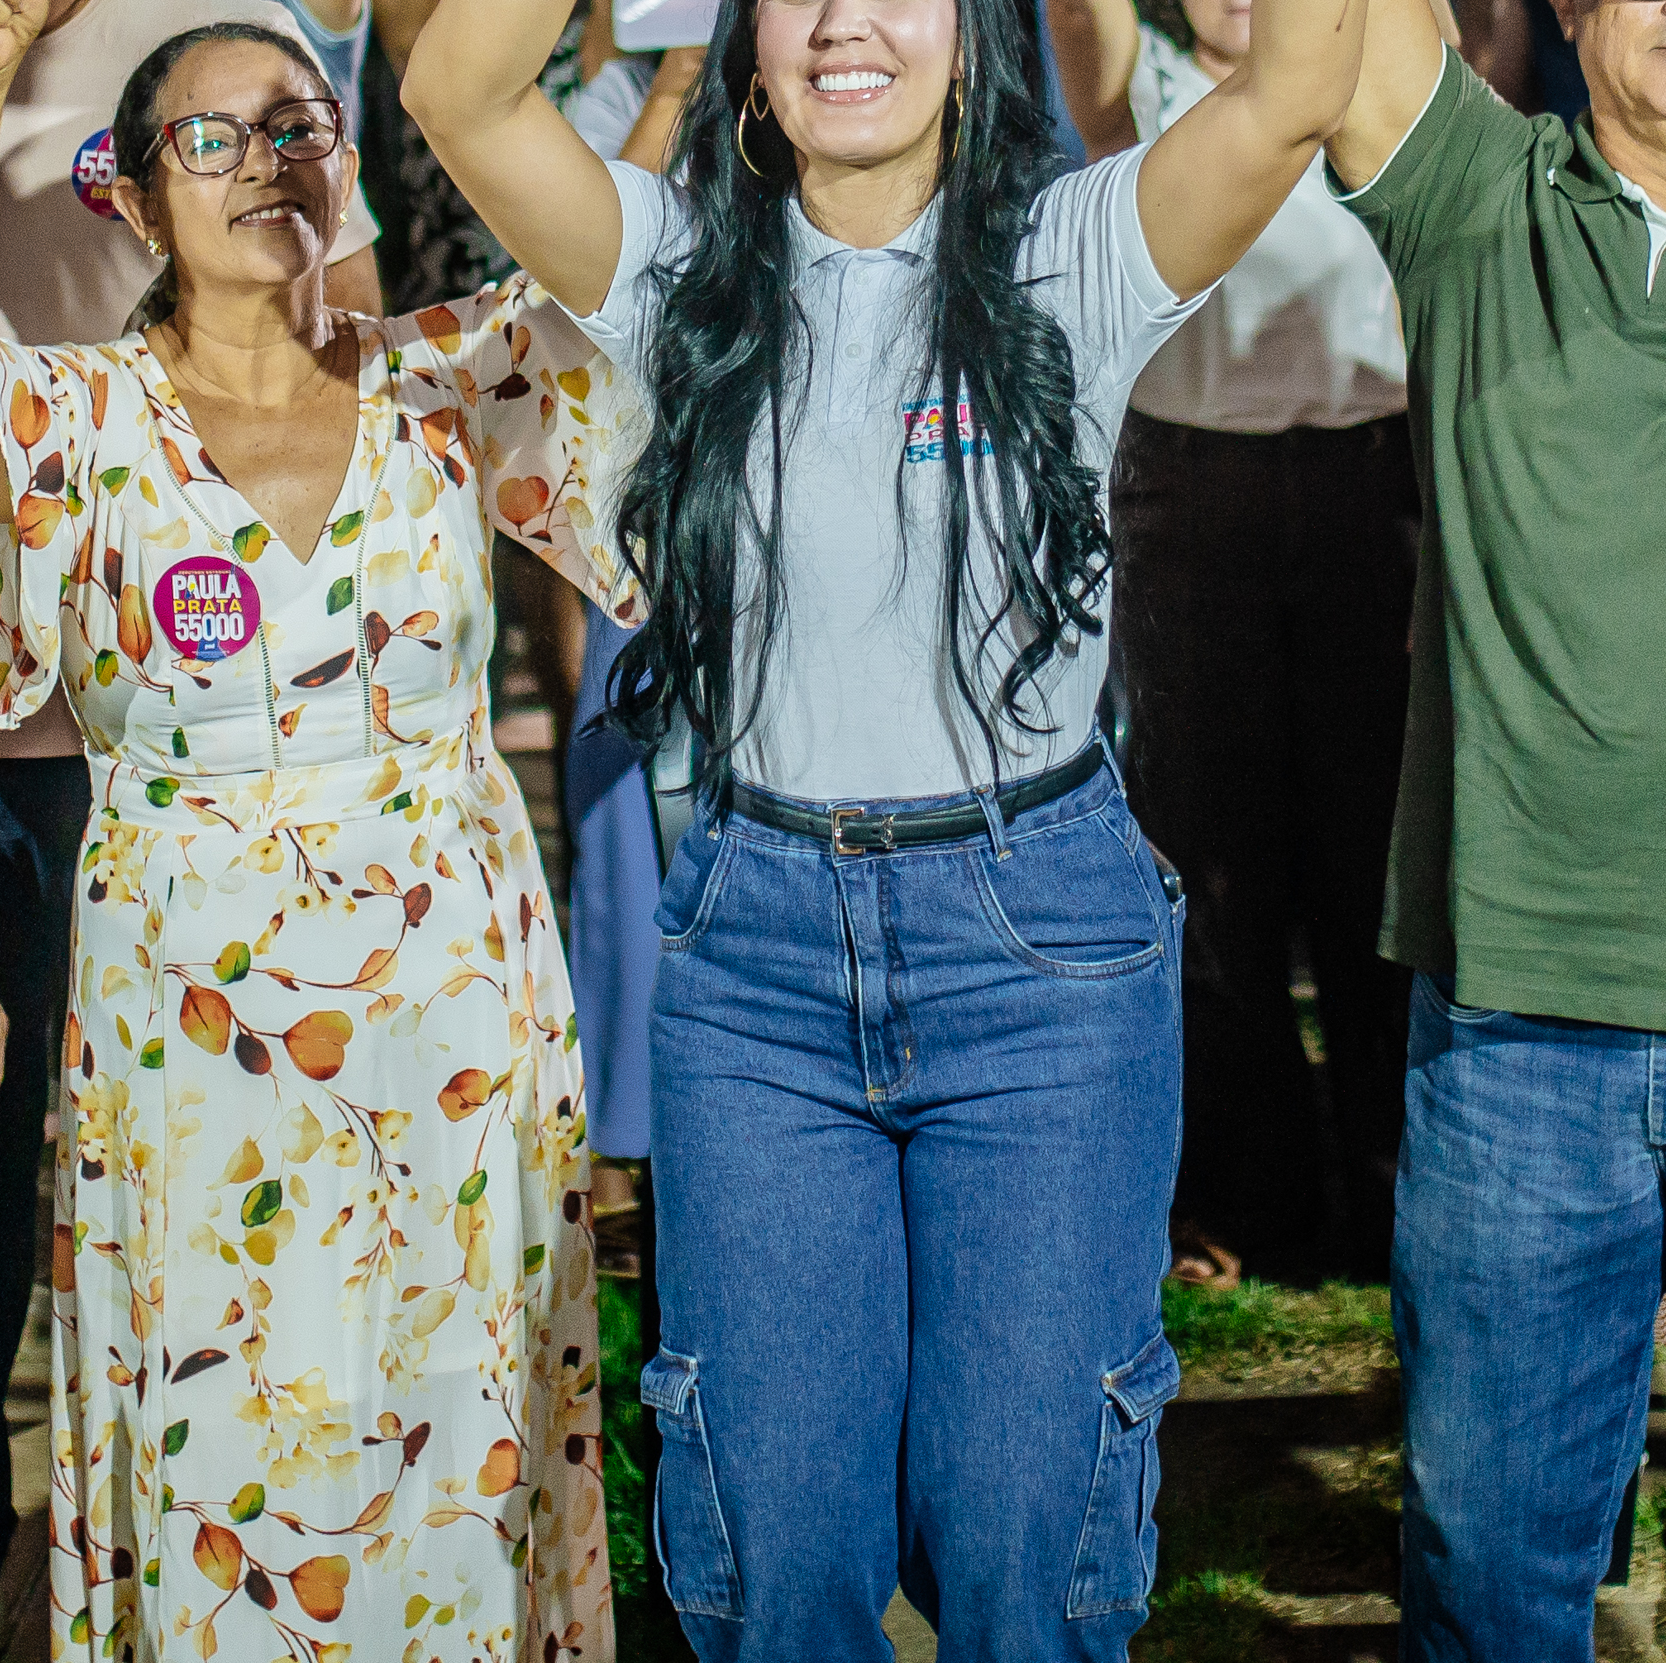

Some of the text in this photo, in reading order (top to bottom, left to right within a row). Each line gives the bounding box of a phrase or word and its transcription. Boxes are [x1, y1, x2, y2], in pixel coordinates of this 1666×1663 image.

[171, 573, 242, 600] PAULA
[172, 598, 243, 614] PRATA
[174, 611, 245, 642] 55000
